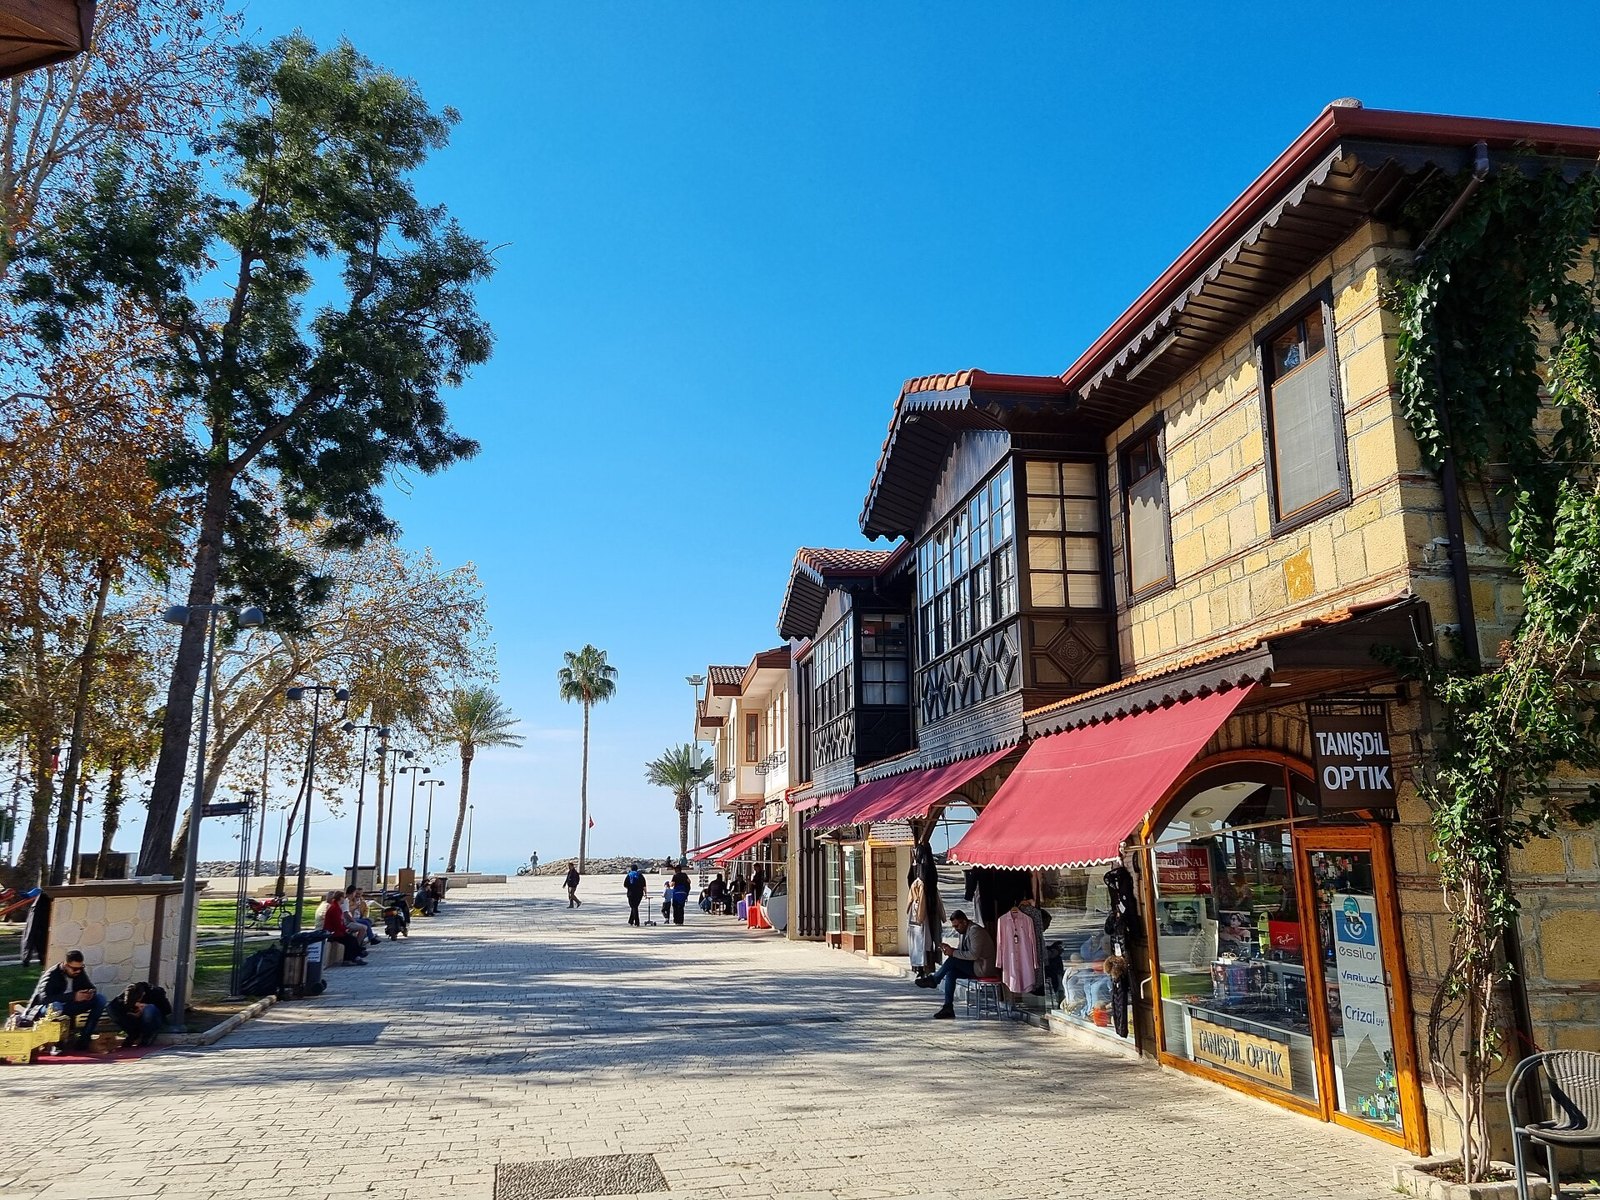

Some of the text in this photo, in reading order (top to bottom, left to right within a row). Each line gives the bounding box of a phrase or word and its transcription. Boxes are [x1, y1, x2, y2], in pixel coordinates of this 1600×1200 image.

[1323, 766, 1392, 790] OPTIK
[1161, 856, 1205, 868] ORIGINAL
[1169, 870, 1198, 881] STORE
[1339, 946, 1376, 960] essilor
[1345, 1005, 1375, 1025] Crizal
[1199, 1030, 1284, 1078] TANIŞDİL OPTİK
